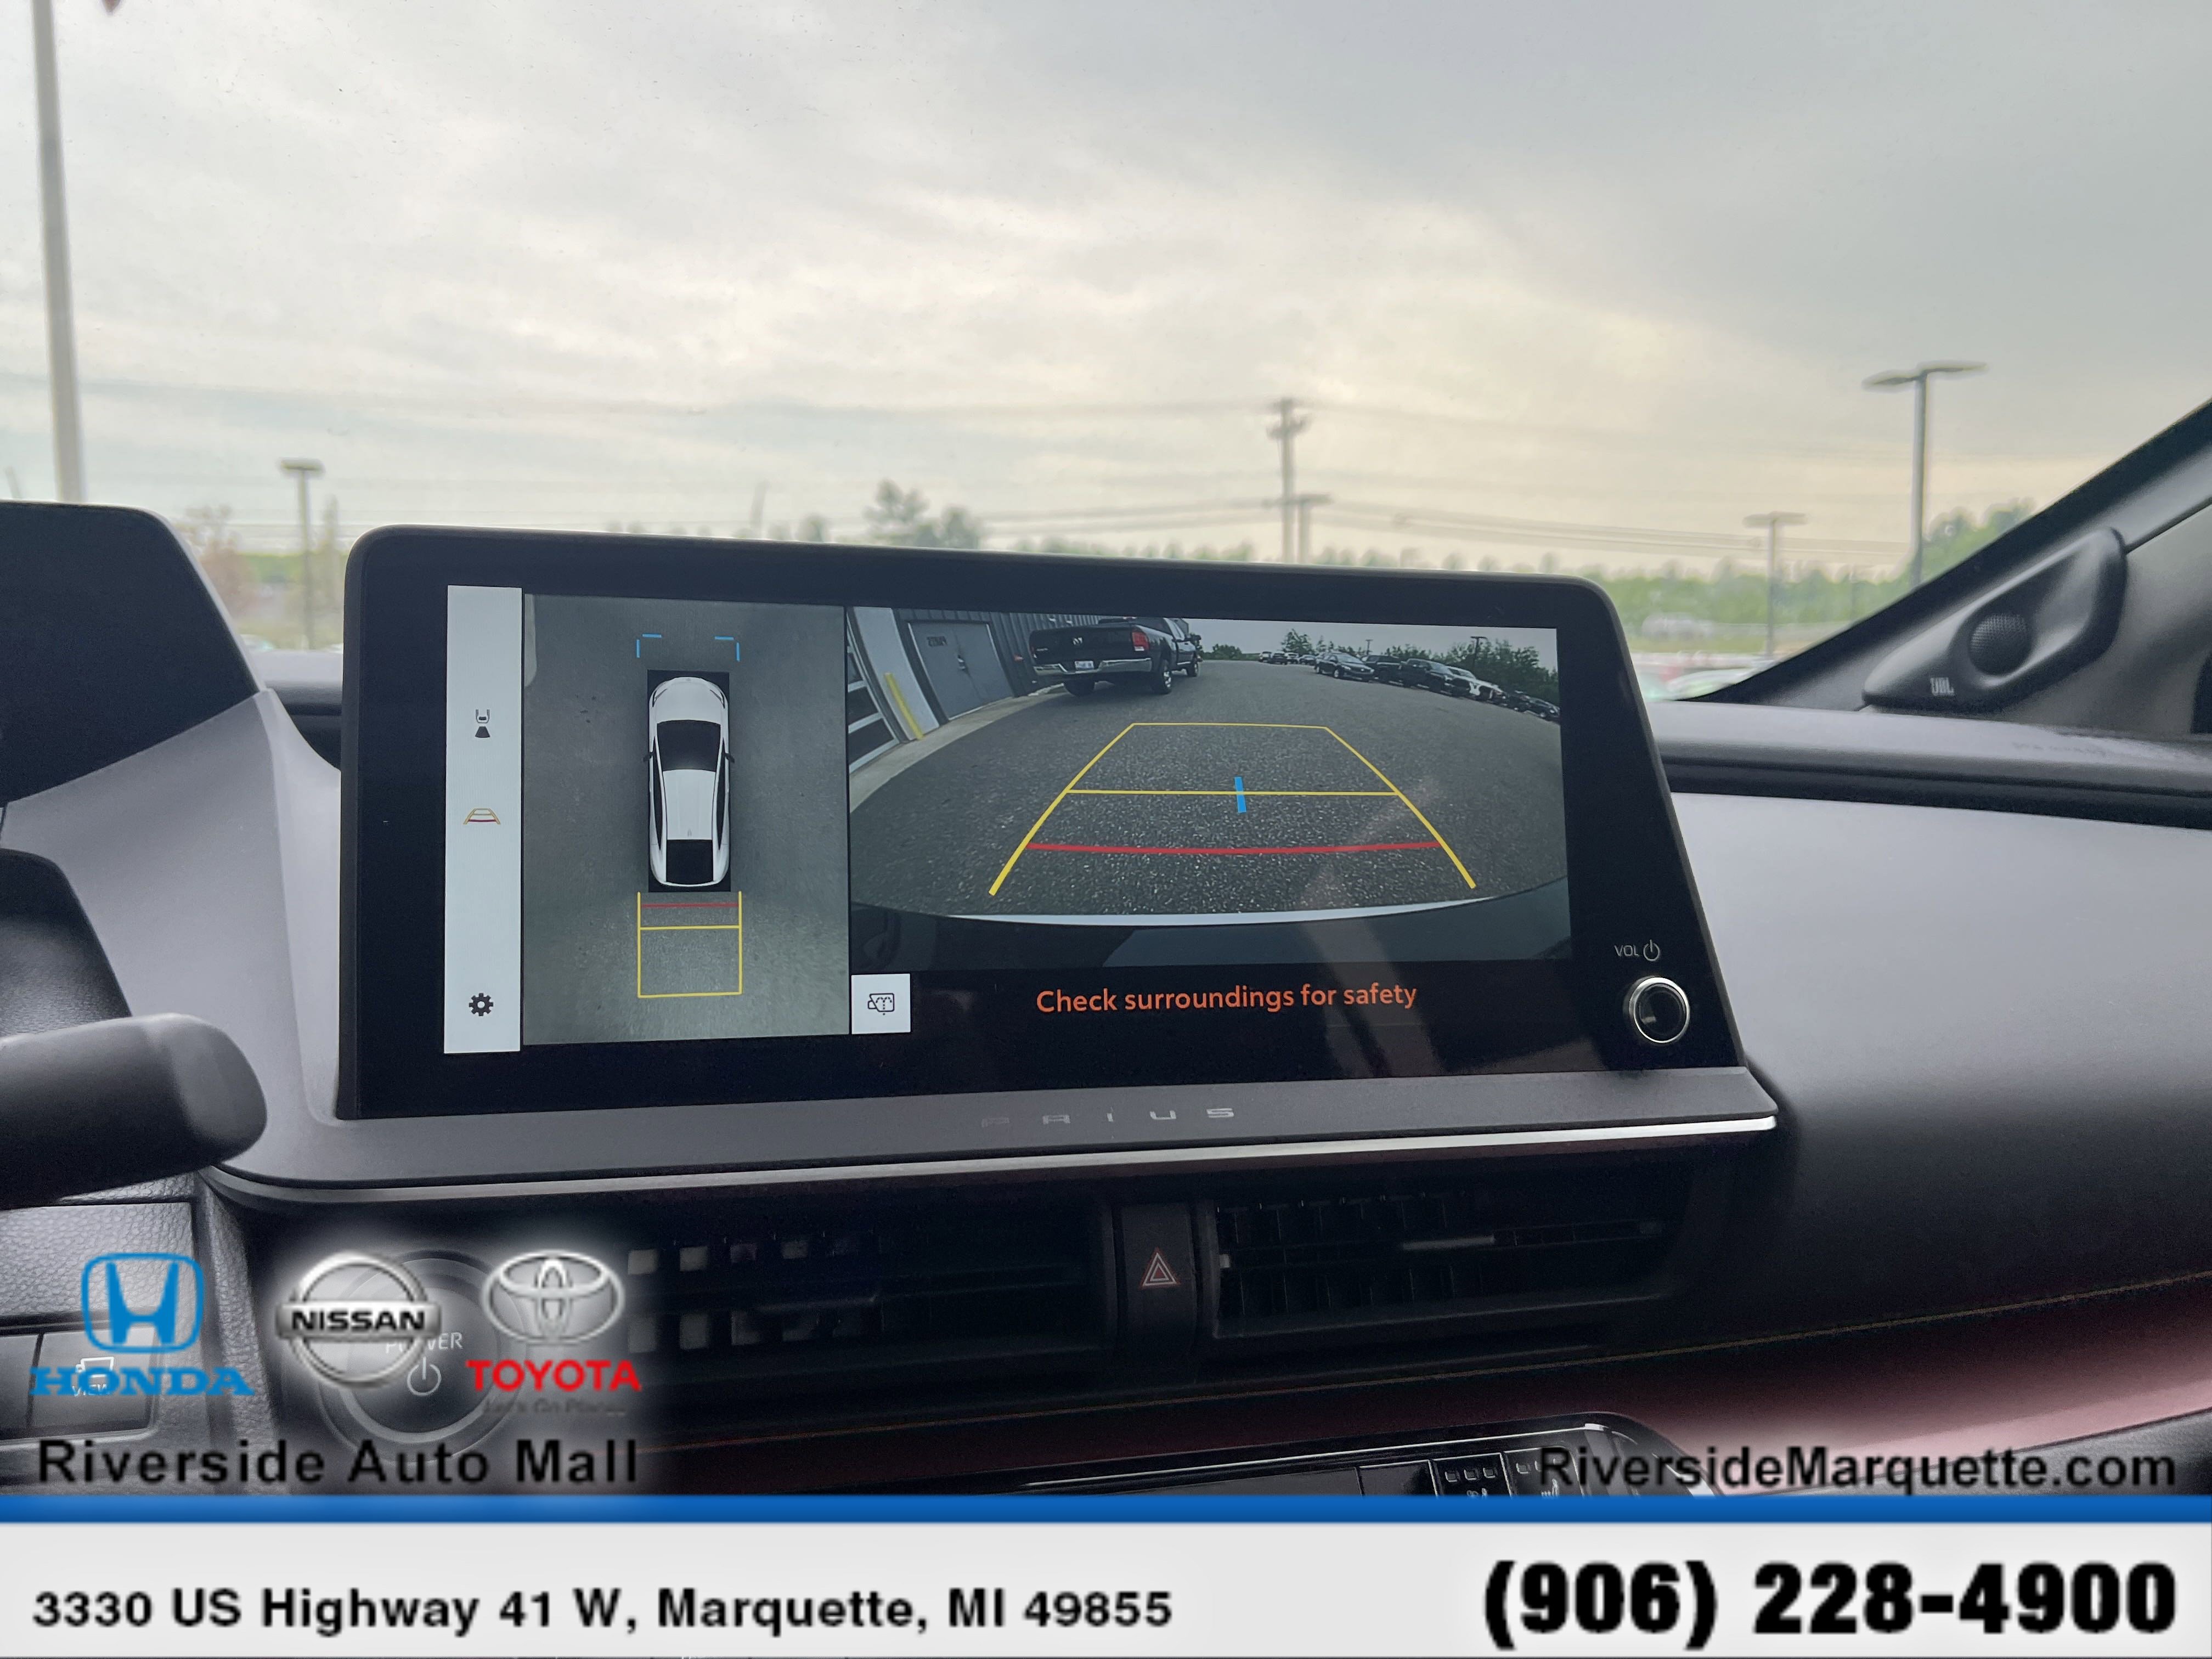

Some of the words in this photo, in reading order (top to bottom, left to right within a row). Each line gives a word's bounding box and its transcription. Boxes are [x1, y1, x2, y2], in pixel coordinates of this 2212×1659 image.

[1614, 945, 1639, 957] VOL
[1036, 988, 1118, 1013] Check
[1124, 984, 1295, 1013] surroundings
[1301, 983, 1335, 1006] for
[1344, 981, 1417, 1009] safety
[981, 1107, 1235, 1128] PRIUS
